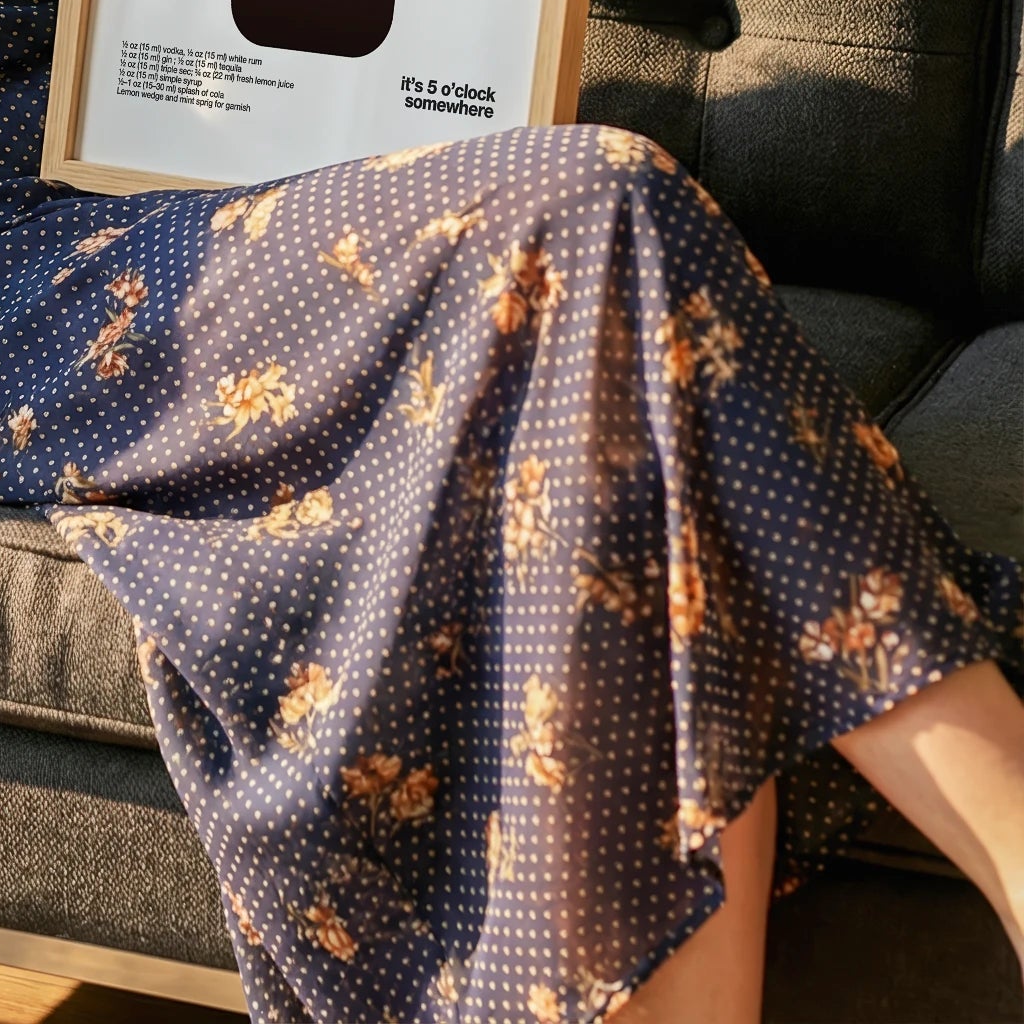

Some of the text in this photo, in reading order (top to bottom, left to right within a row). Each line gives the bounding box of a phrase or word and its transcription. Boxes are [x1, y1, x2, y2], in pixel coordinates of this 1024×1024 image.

[139, 52, 148, 61] (15
[150, 54, 160, 63] ml)
[162, 56, 172, 64] gin
[196, 59, 205, 68] (15
[207, 62, 217, 70] ml)
[219, 63, 241, 72] tequila
[140, 43, 149, 51] (15
[151, 45, 161, 53] ml)
[163, 47, 185, 56] vodka,
[205, 51, 215, 60] (15
[217, 53, 227, 62] ml)
[229, 55, 247, 63] white
[137, 71, 146, 79] (15
[148, 73, 158, 82] ml)
[160, 75, 182, 84] simple
[183, 79, 202, 87] syrup
[138, 61, 147, 70] (15
[149, 63, 159, 72] ml)
[161, 65, 177, 74] triple
[213, 71, 223, 80] (22
[225, 74, 234, 82] ml)
[237, 74, 253, 83] fresh
[255, 77, 276, 86] lemon
[277, 80, 294, 88] juice
[166, 85, 176, 94] ml)
[178, 87, 199, 96] splash
[427, 80, 437, 94] 5
[117, 87, 139, 97] Lemon
[141, 91, 163, 101] wedge
[180, 96, 195, 104] mint
[196, 99, 213, 108] sprig
[215, 100, 224, 108] for
[226, 103, 251, 112] garnish
[405, 97, 493, 118] somewhere
